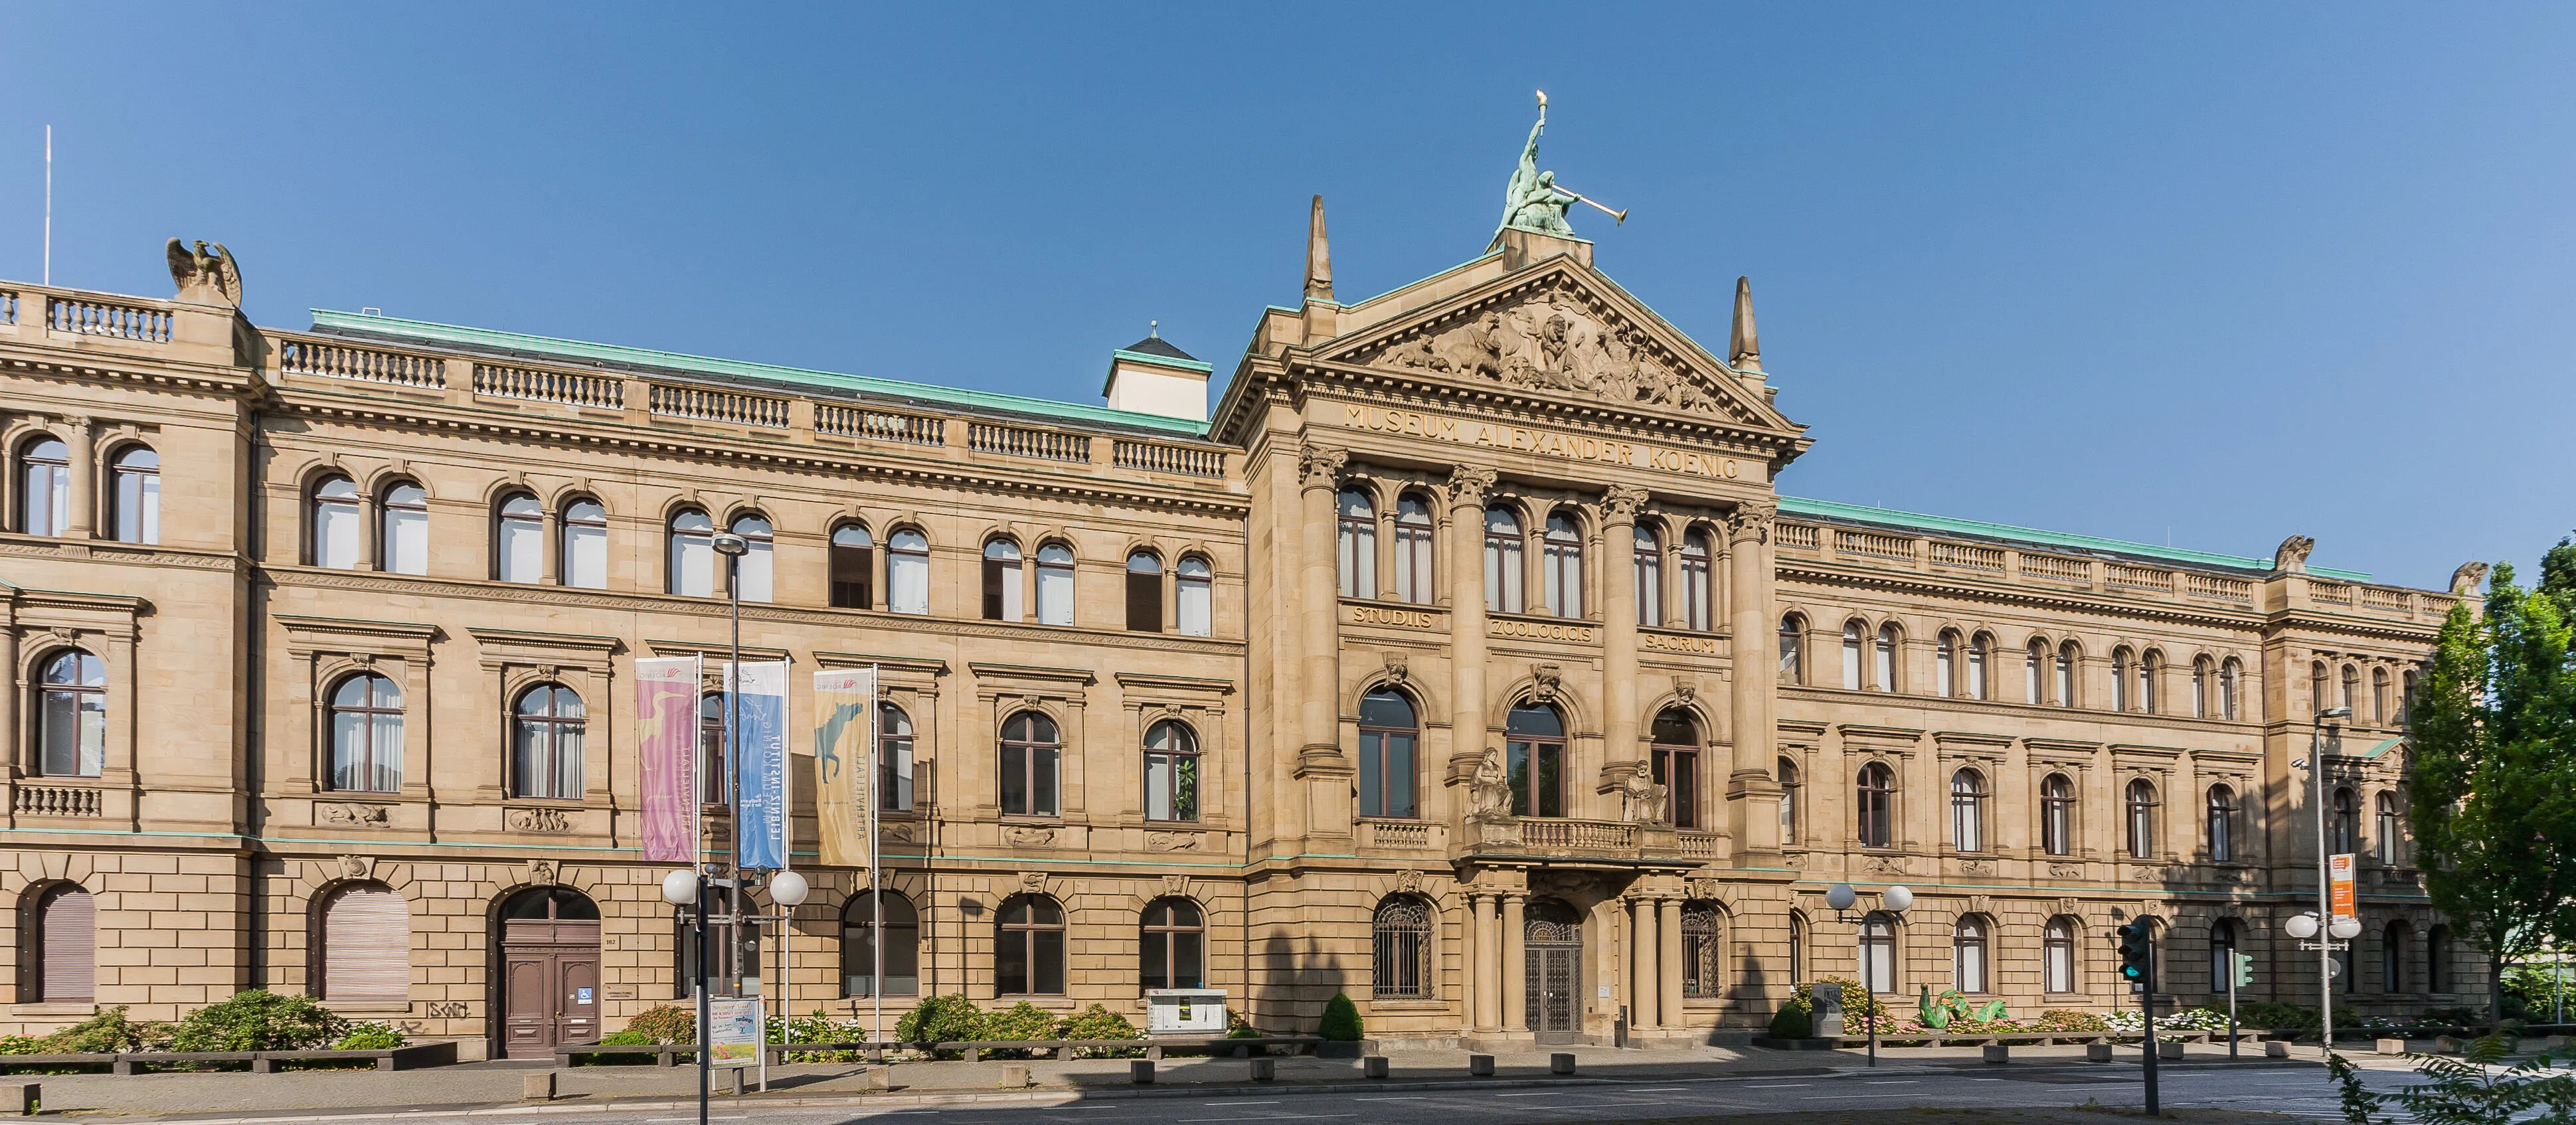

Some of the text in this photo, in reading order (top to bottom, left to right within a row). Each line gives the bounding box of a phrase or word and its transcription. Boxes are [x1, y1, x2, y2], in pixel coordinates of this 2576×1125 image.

[1345, 403, 1738, 479] MUSEUM ALEXANDER KOENIG
[1353, 606, 1432, 628] STUDIIS
[1490, 620, 1592, 643] ZOOLOGICIS
[1645, 634, 1715, 653] SACRUM
